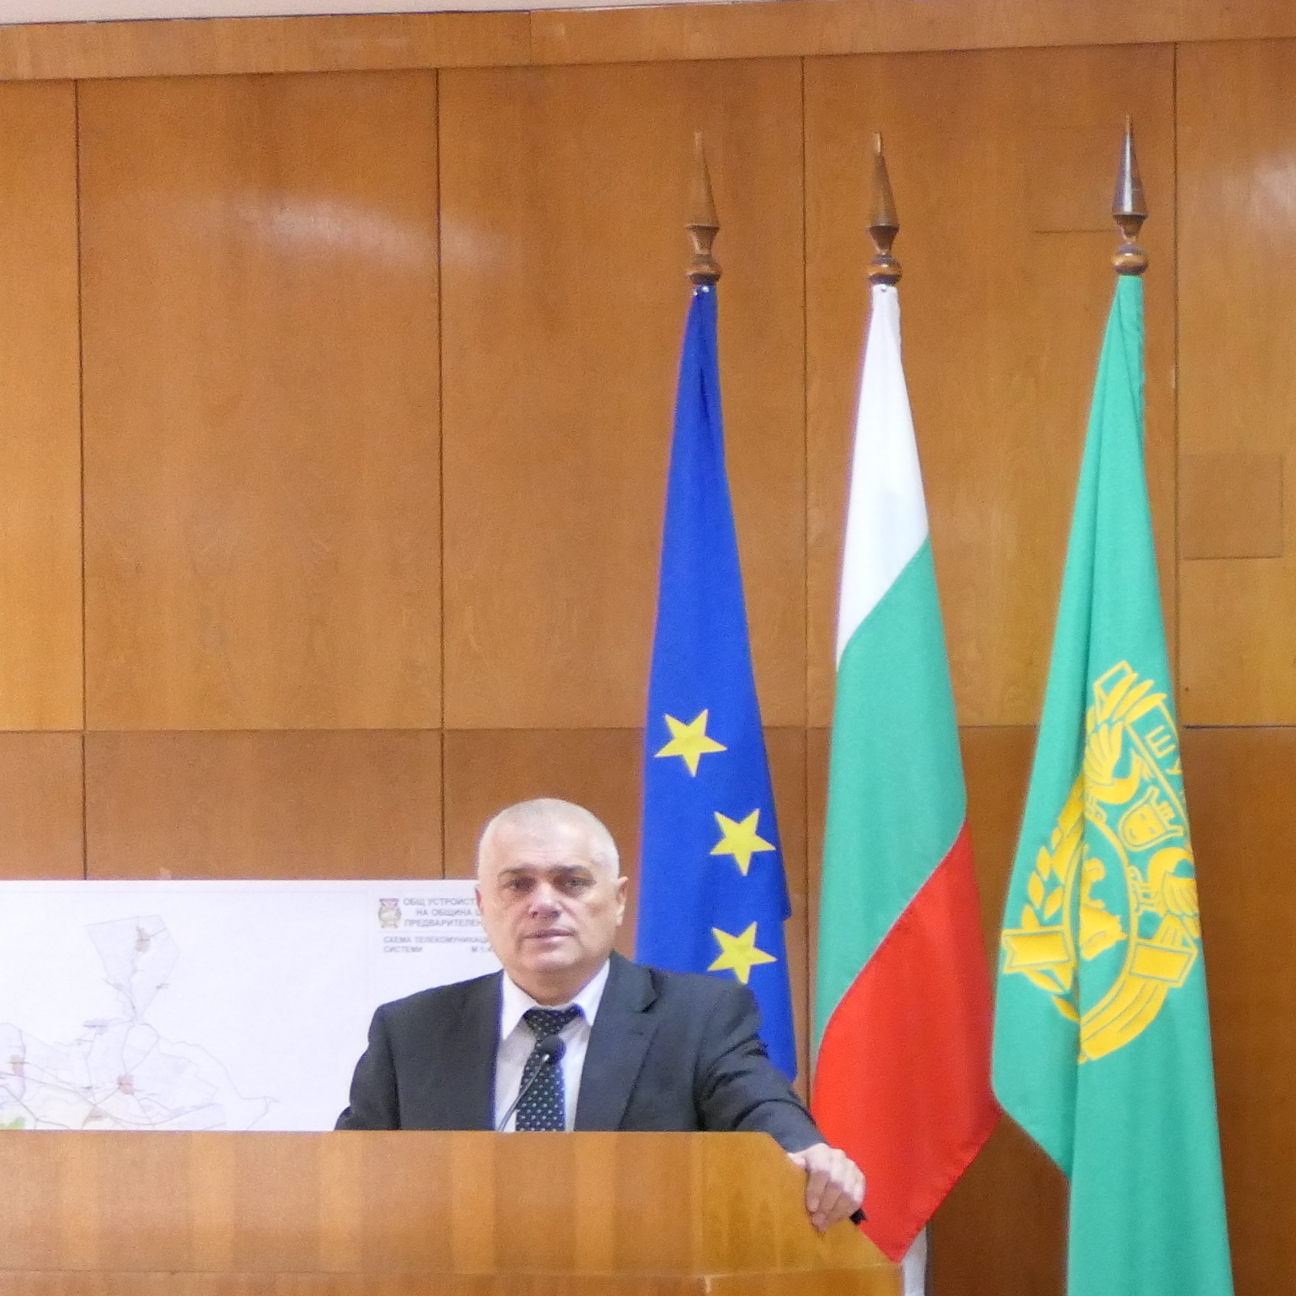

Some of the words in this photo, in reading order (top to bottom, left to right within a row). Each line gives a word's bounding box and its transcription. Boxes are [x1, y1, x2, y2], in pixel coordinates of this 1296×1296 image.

[403, 898, 425, 906] ОБЩ
[427, 897, 476, 906] УСТРОЙСТ
[431, 909, 472, 917] ОБЩИНА
